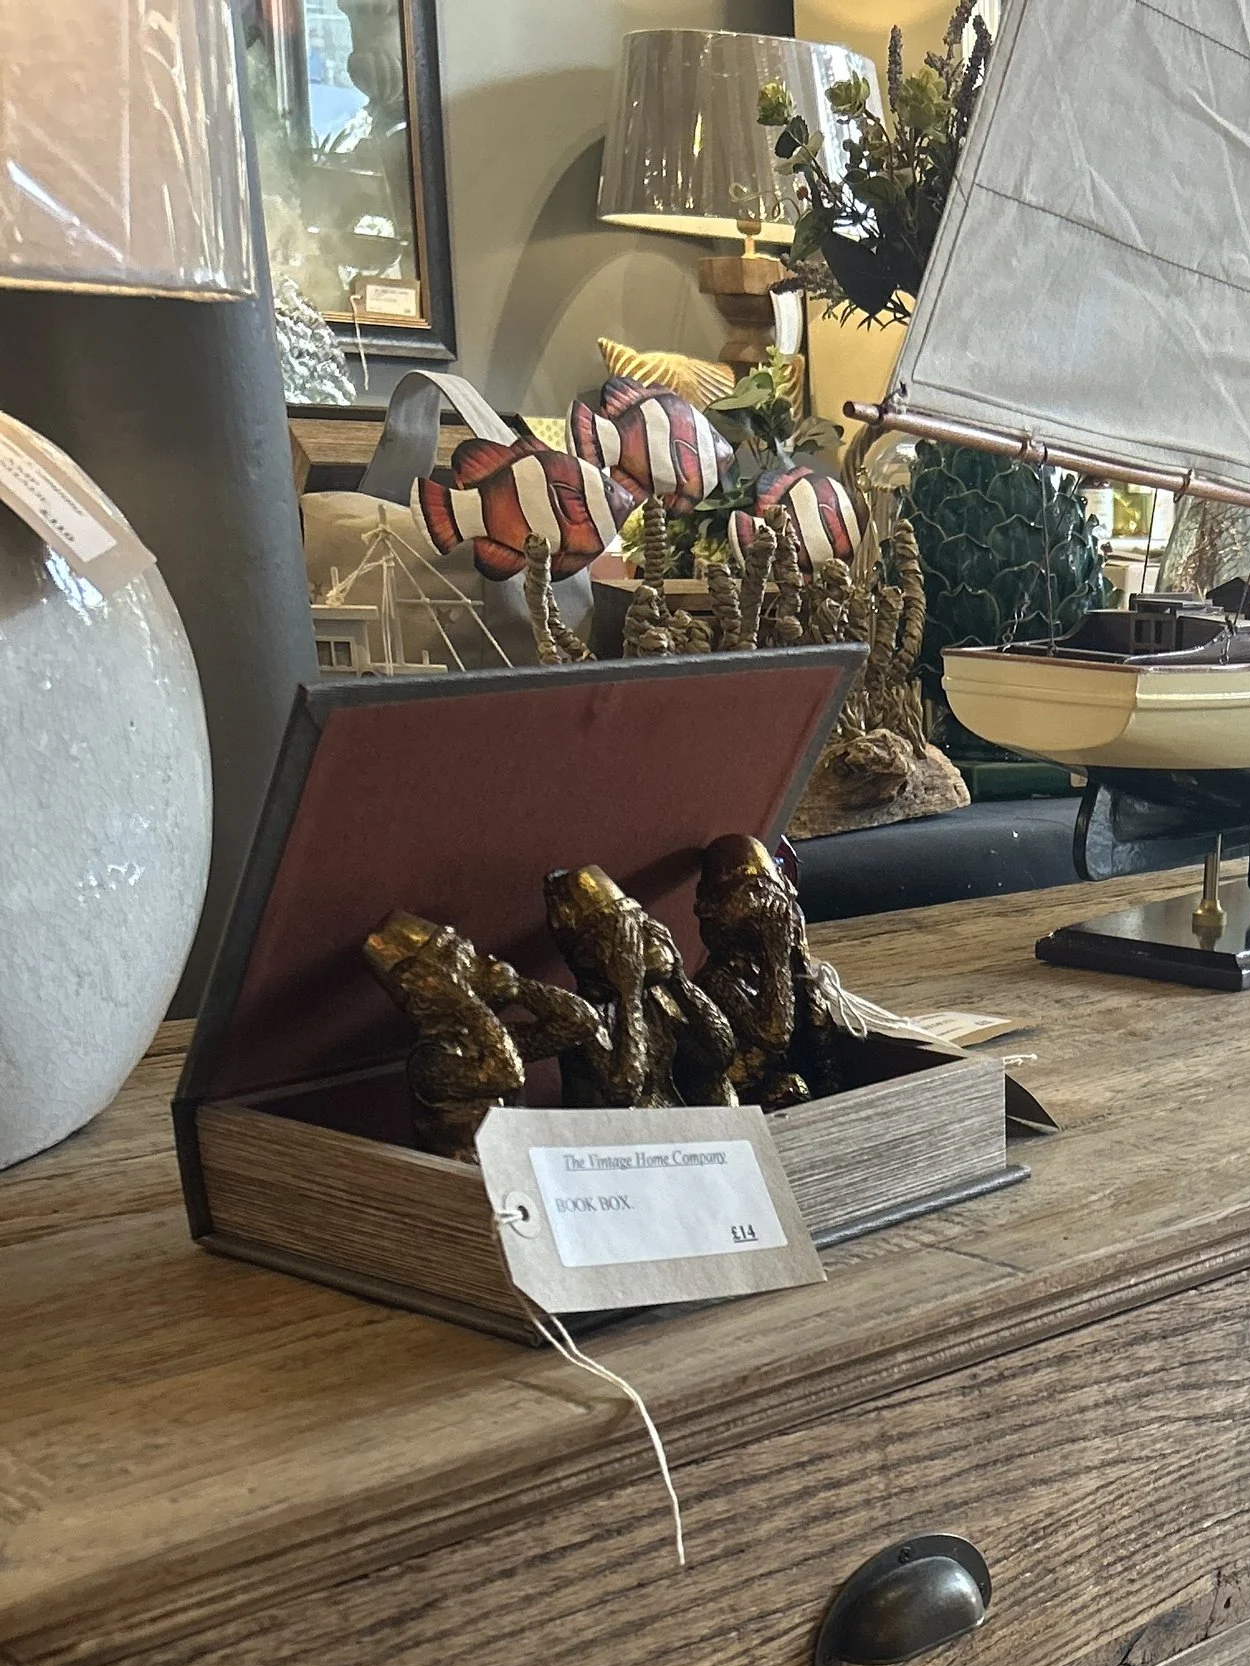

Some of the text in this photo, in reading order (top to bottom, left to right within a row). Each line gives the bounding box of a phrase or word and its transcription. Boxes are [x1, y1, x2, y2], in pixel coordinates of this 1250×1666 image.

[563, 1150, 728, 1171] The Vintage Home Company
[555, 1197, 597, 1213] BOOK
[731, 1224, 758, 1243] £14
